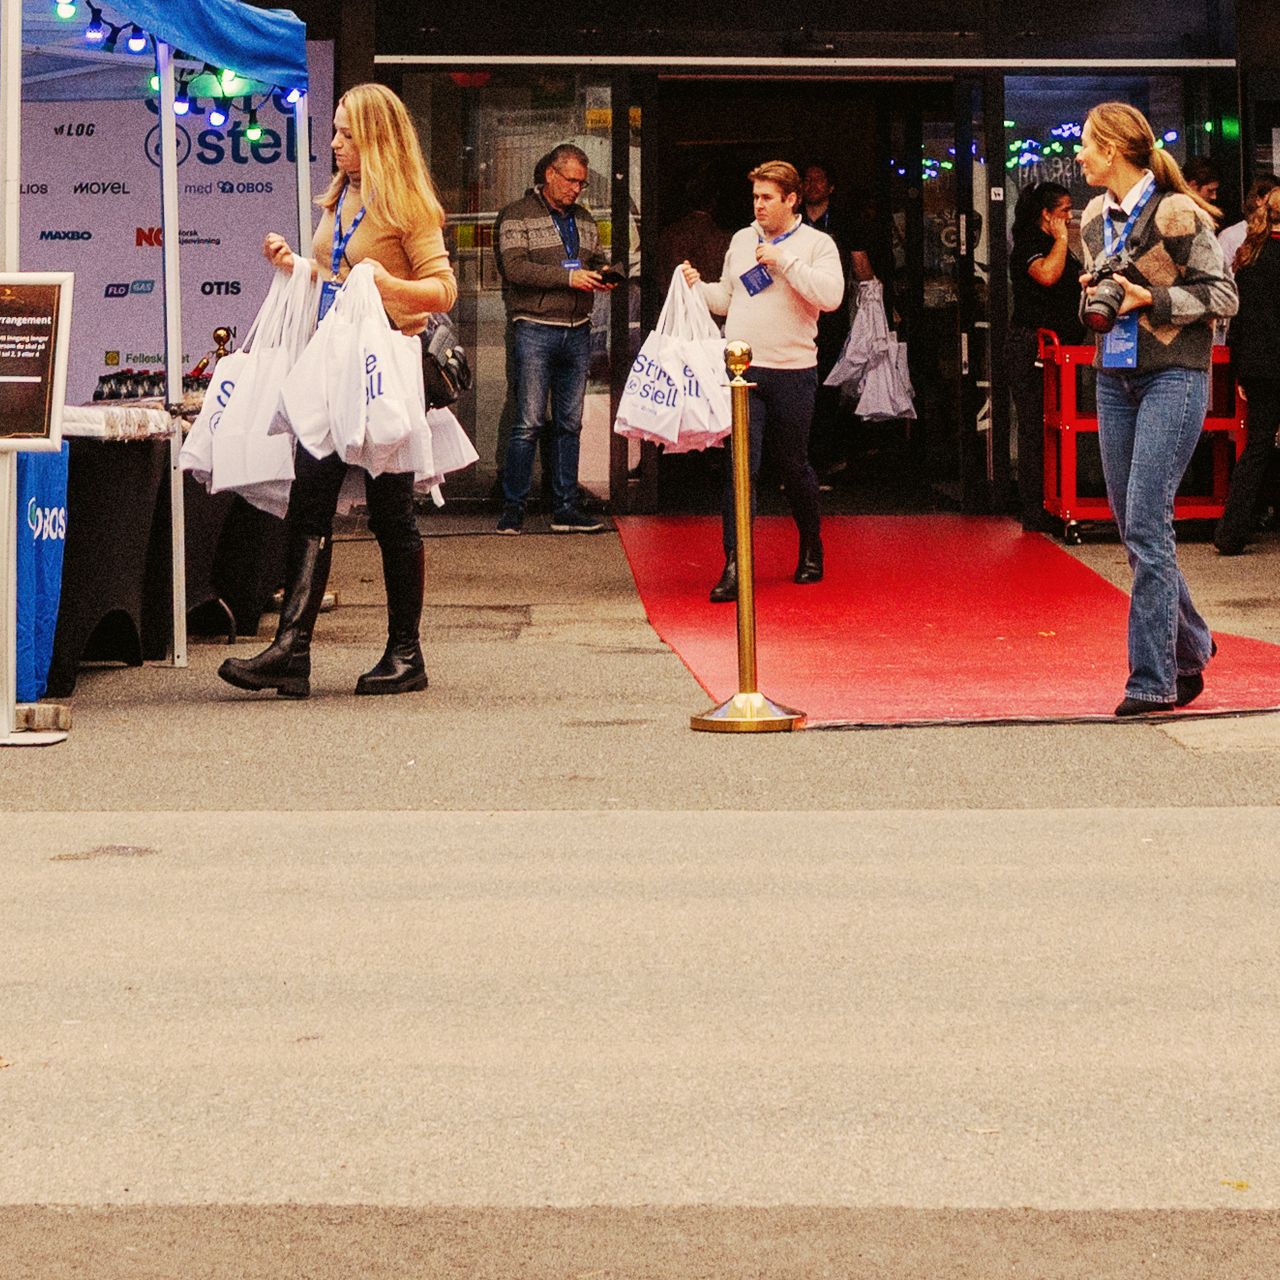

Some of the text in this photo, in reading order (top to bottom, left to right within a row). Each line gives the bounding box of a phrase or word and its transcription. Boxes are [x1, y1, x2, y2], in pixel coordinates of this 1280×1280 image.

[185, 182, 273, 193] med OBOS
[39, 231, 92, 241] MAXBO
[201, 281, 241, 295] OTIS
